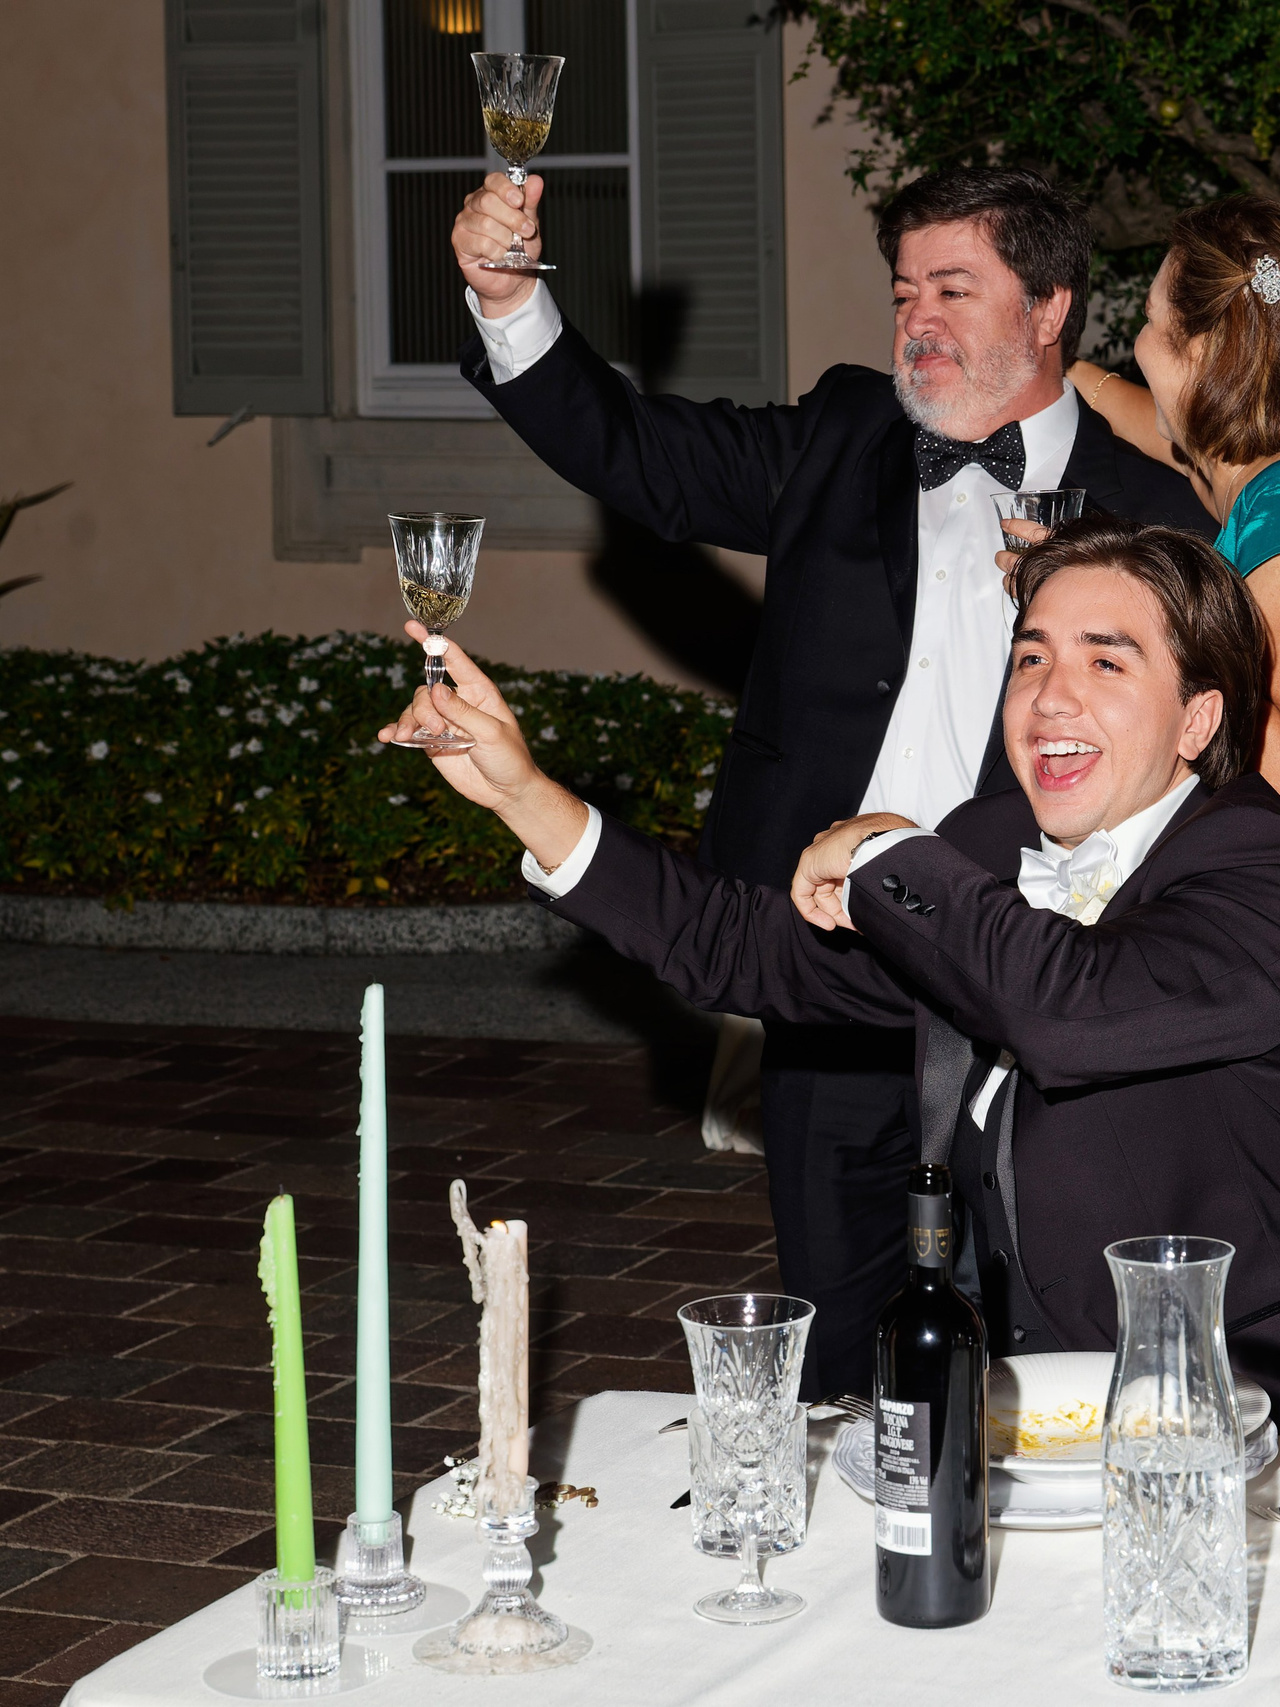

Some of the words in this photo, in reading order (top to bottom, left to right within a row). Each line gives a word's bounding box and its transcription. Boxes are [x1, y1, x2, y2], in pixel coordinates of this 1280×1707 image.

[879, 1398, 914, 1416] CAPARZO
[882, 1412, 909, 1428] TOSCANA
[880, 1433, 915, 1451] SANGIOVESE
